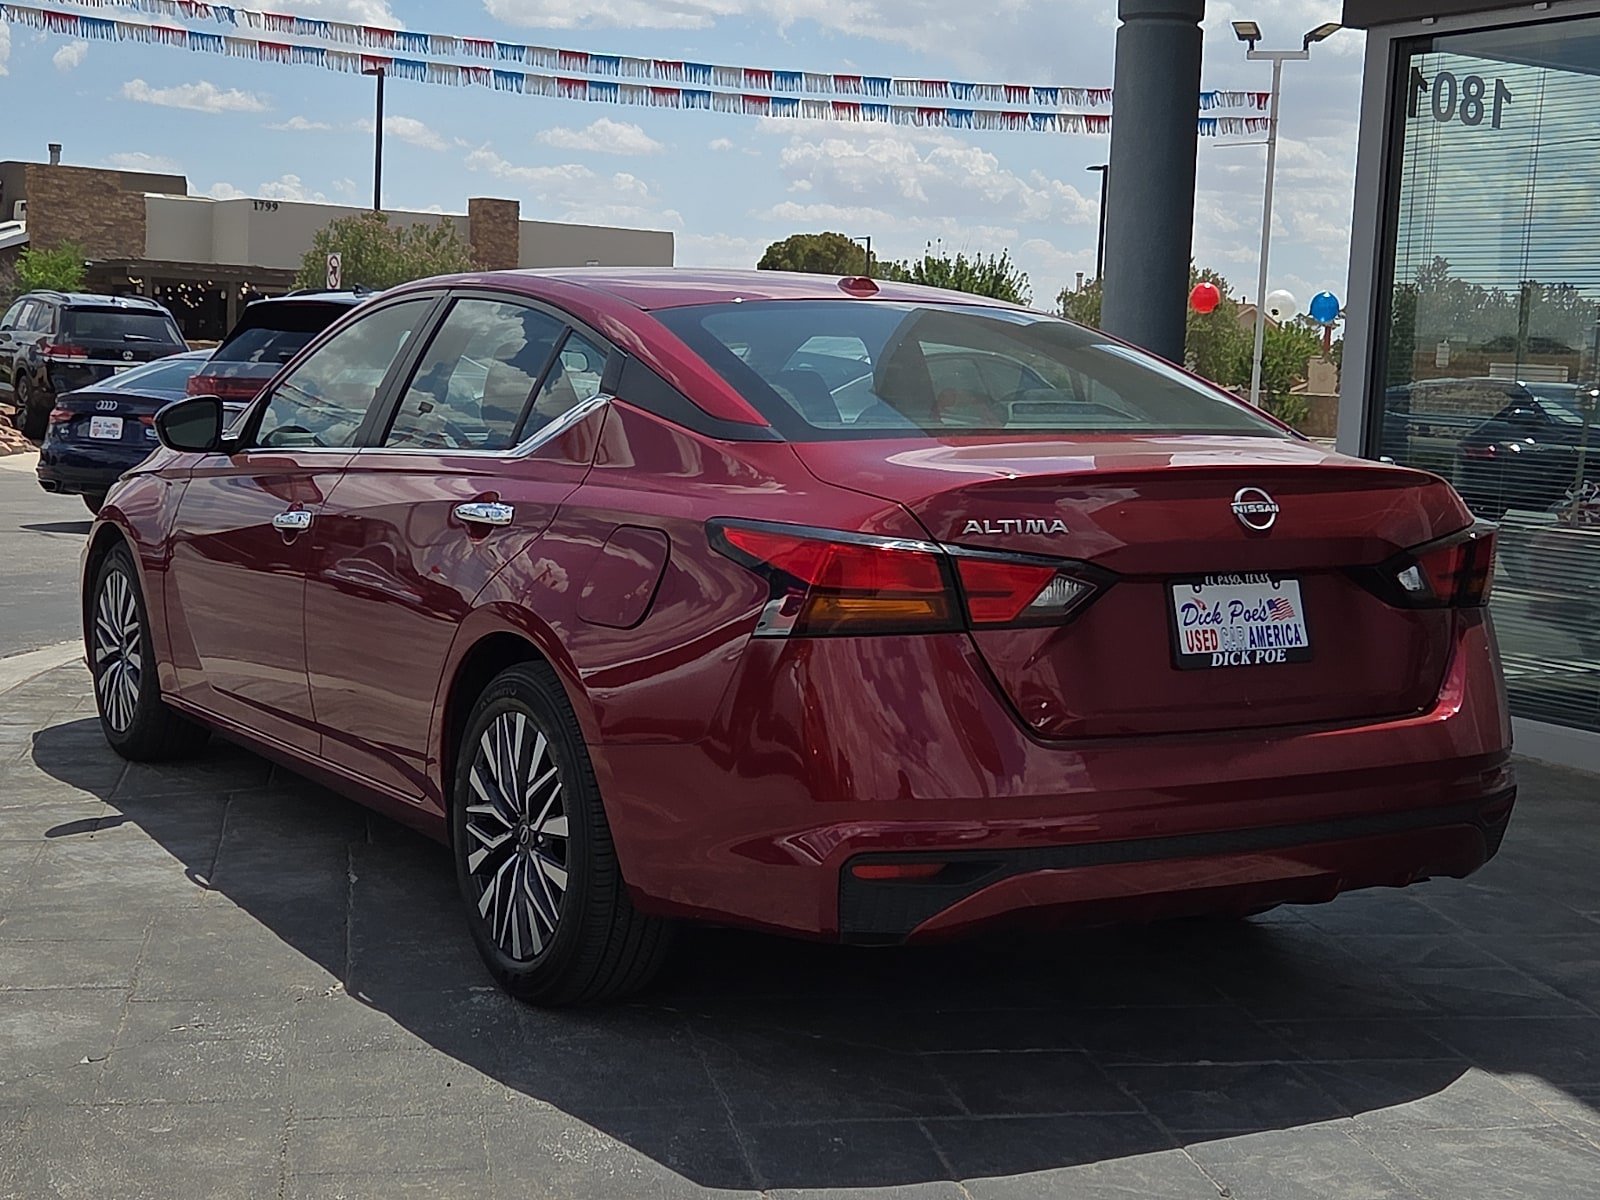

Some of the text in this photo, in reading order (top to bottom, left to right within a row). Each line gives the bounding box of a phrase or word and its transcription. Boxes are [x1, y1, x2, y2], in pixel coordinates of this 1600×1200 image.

[253, 201, 279, 212] 1799
[1232, 503, 1279, 514] NISSAN
[962, 519, 1069, 534] ALTIMA
[1181, 599, 1268, 626] Dick Poe's
[1185, 628, 1218, 652] USED
[1249, 623, 1302, 648] AMERICA
[1210, 648, 1287, 667] DICK POE
